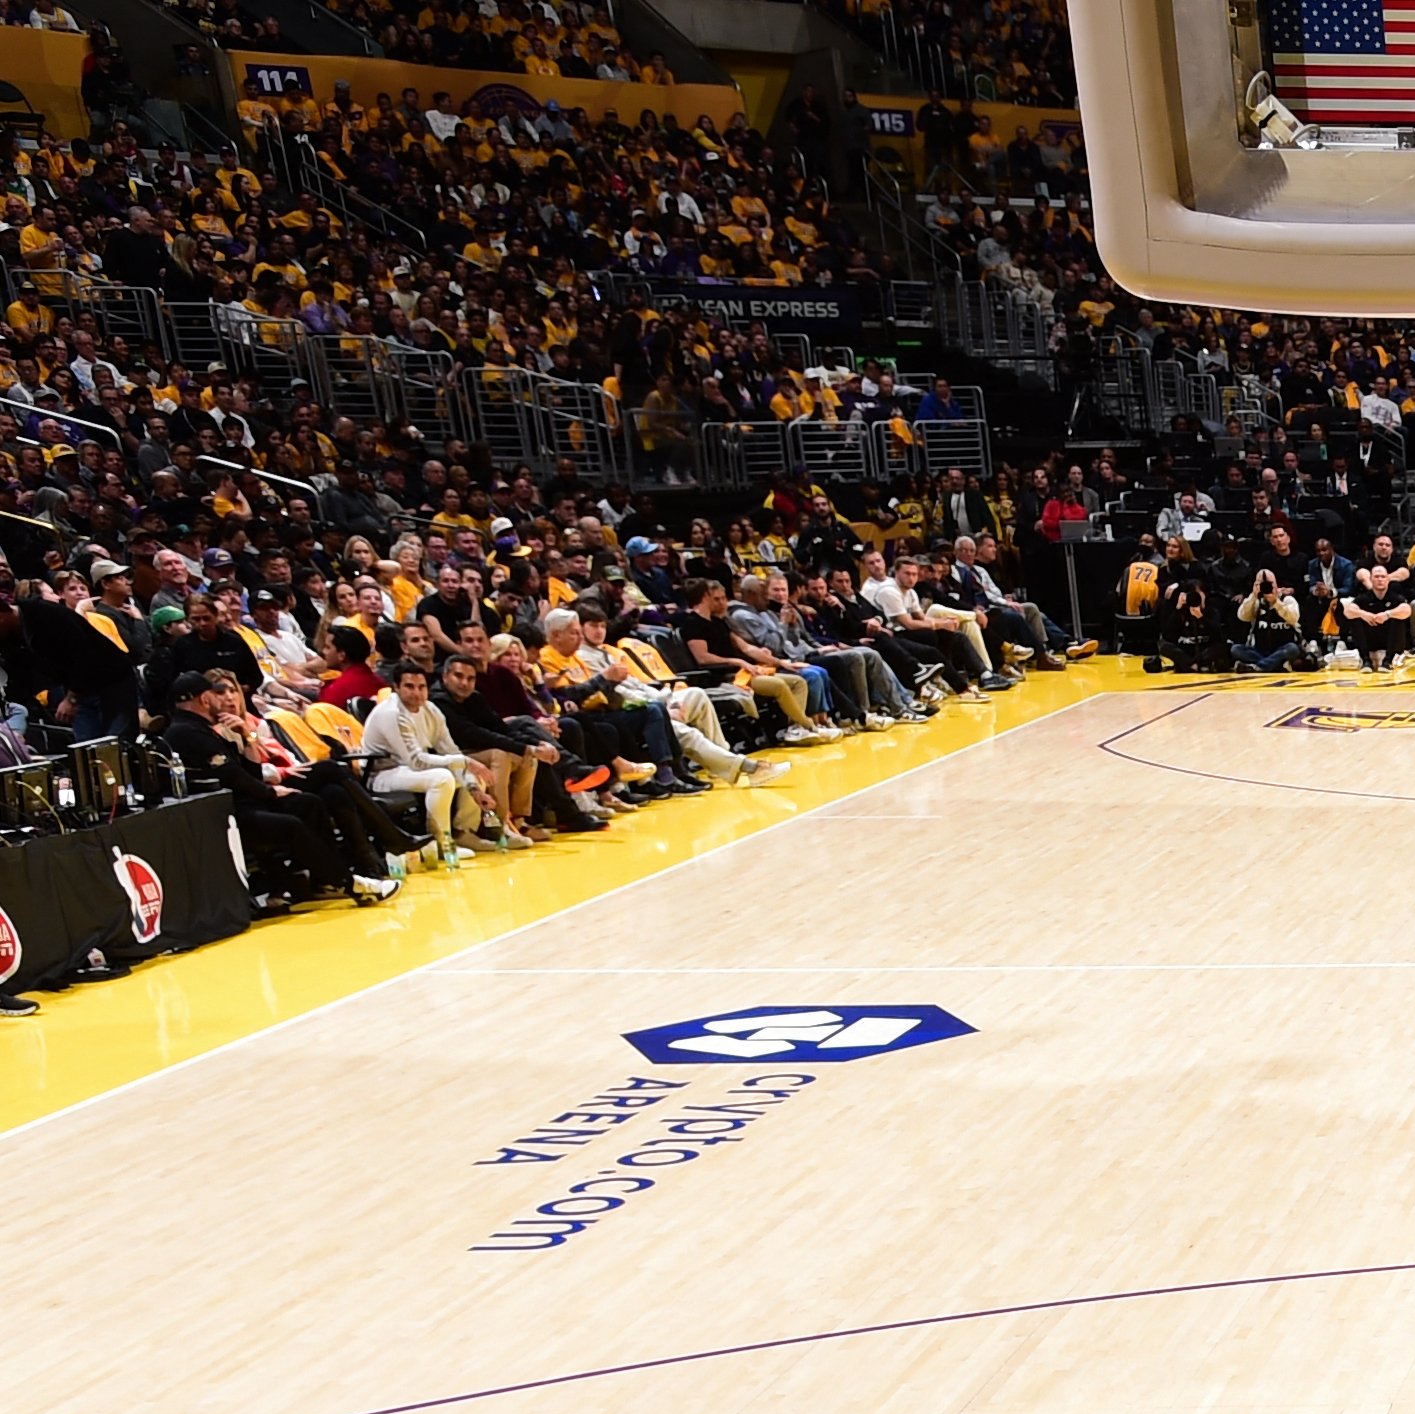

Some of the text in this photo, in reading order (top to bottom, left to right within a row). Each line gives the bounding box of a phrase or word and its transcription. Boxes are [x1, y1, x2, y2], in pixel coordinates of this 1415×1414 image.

[871, 111, 905, 132] 115
[750, 300, 841, 318] EXPRESS
[1134, 567, 1153, 583] 77
[471, 1076, 692, 1166] ARENA
[465, 1073, 817, 1252] crypto.com
